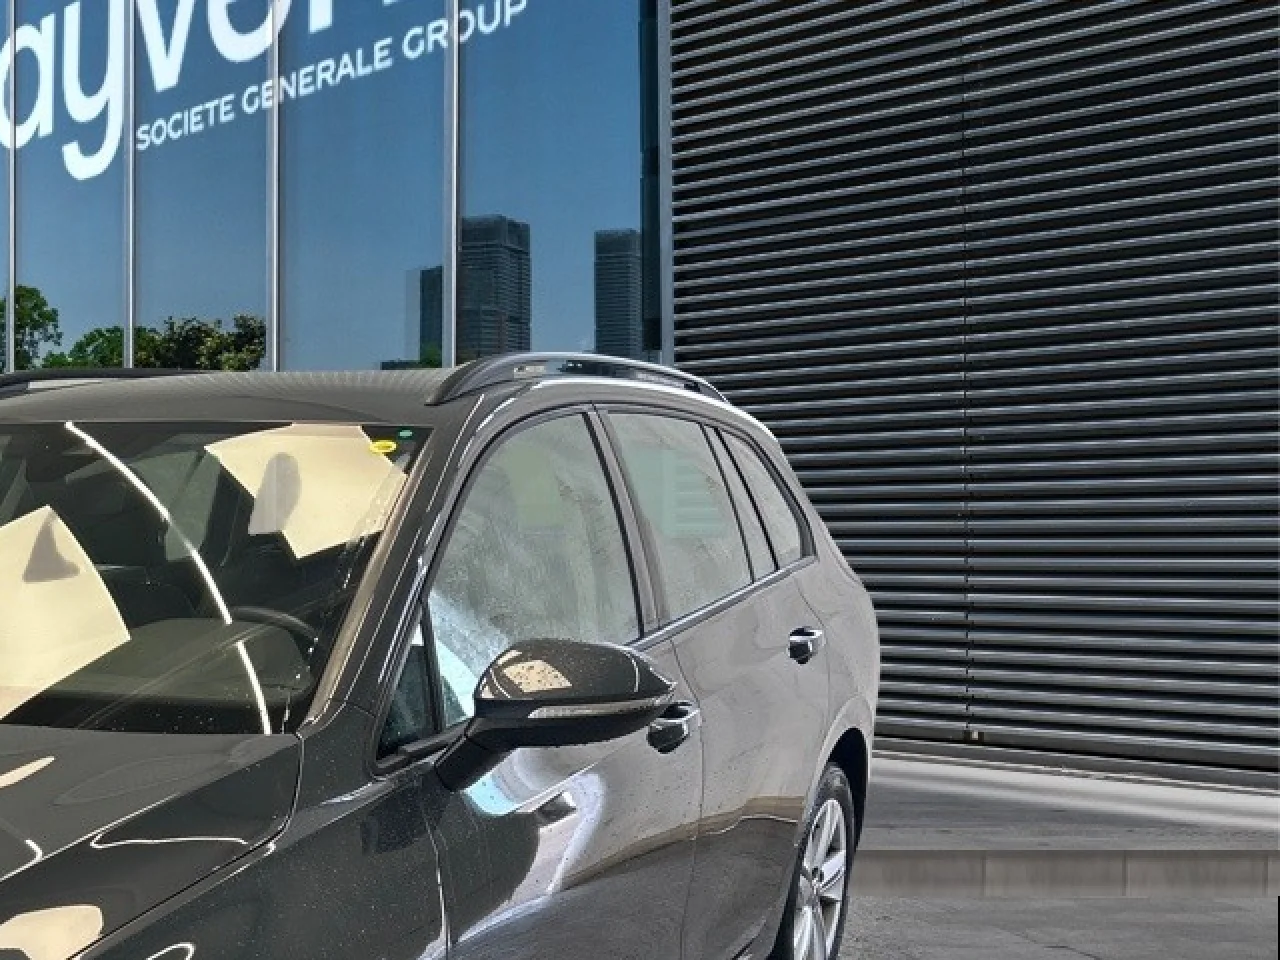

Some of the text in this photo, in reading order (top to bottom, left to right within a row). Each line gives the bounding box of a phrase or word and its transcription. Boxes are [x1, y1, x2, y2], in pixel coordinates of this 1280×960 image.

[135, 0, 527, 151] SOCIETE GENERALE GROUP
